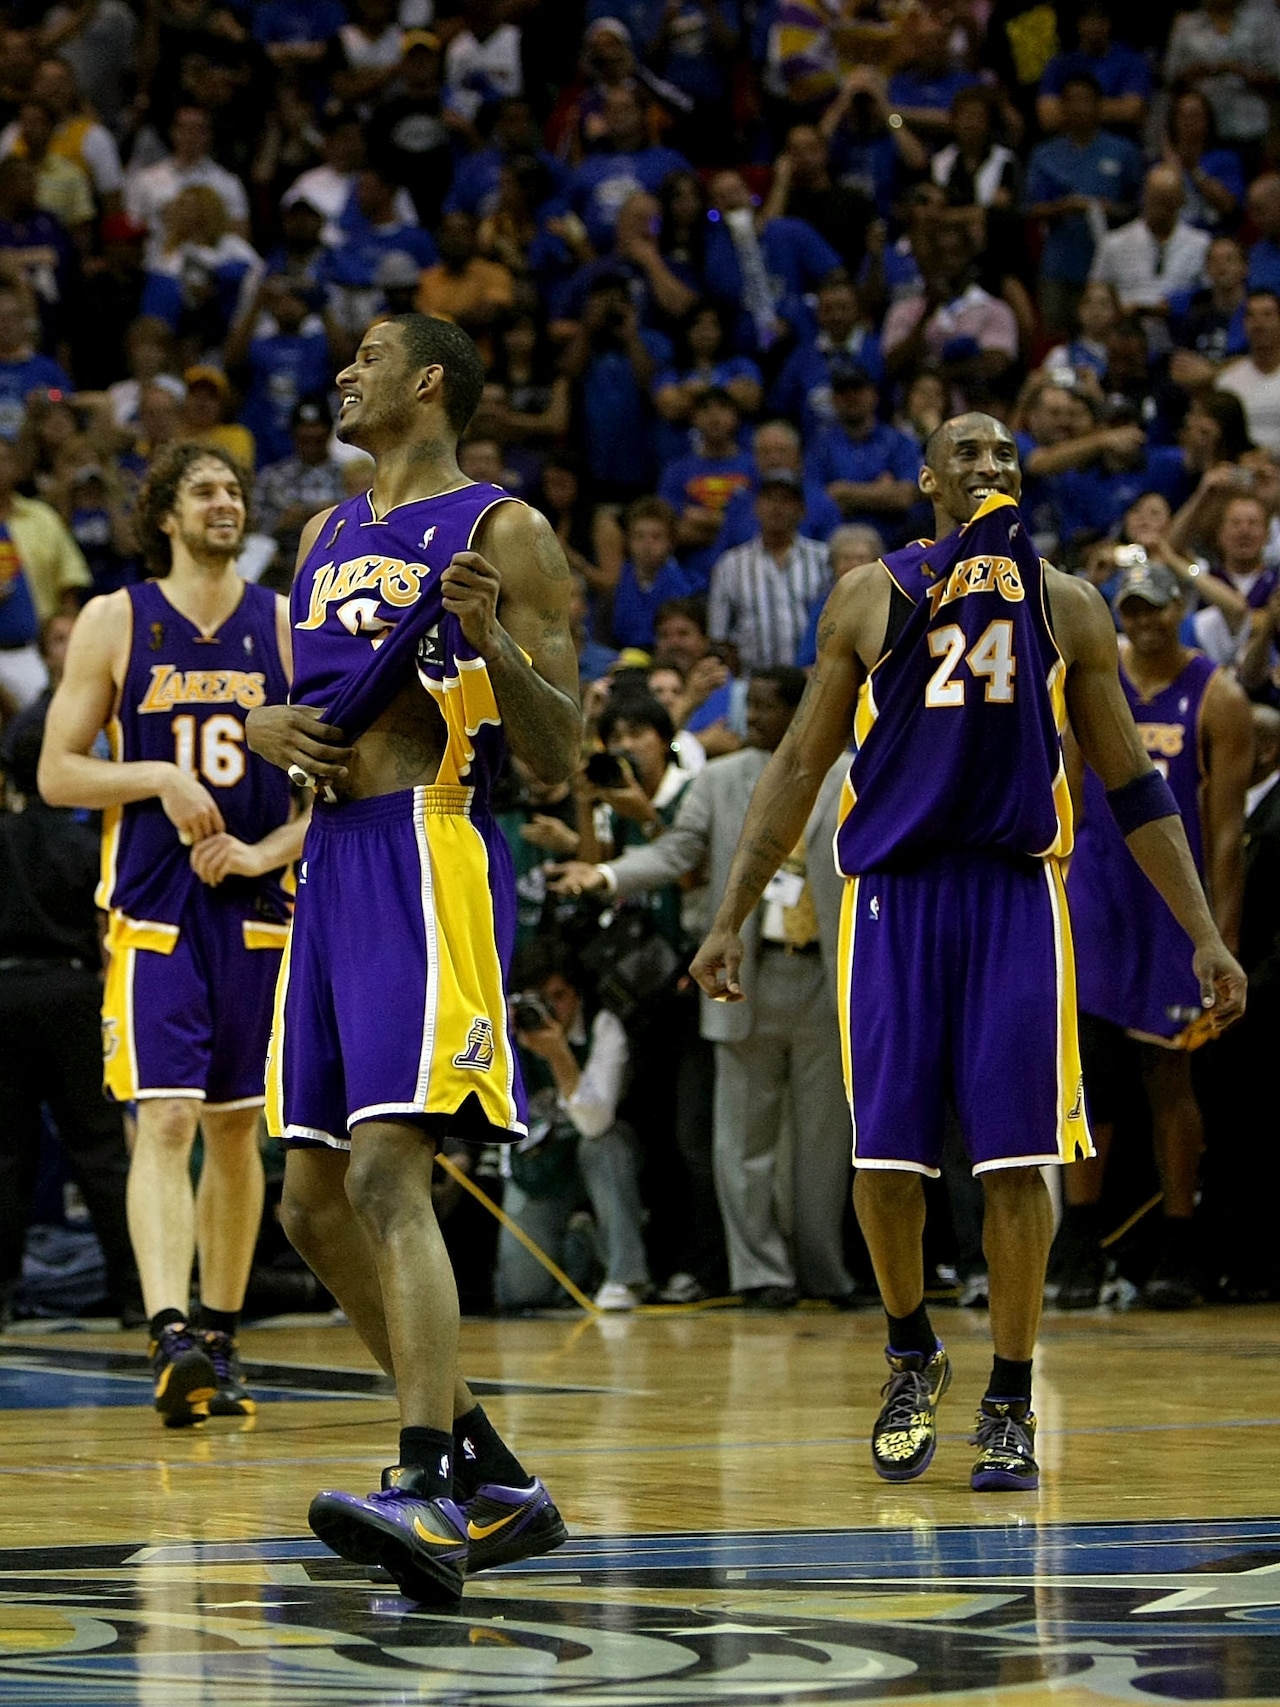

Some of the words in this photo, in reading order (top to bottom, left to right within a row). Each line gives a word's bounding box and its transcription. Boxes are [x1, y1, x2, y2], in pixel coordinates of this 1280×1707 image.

[137, 664, 267, 714] LAKERS
[925, 619, 1016, 708] 24
[171, 713, 246, 788] 16
